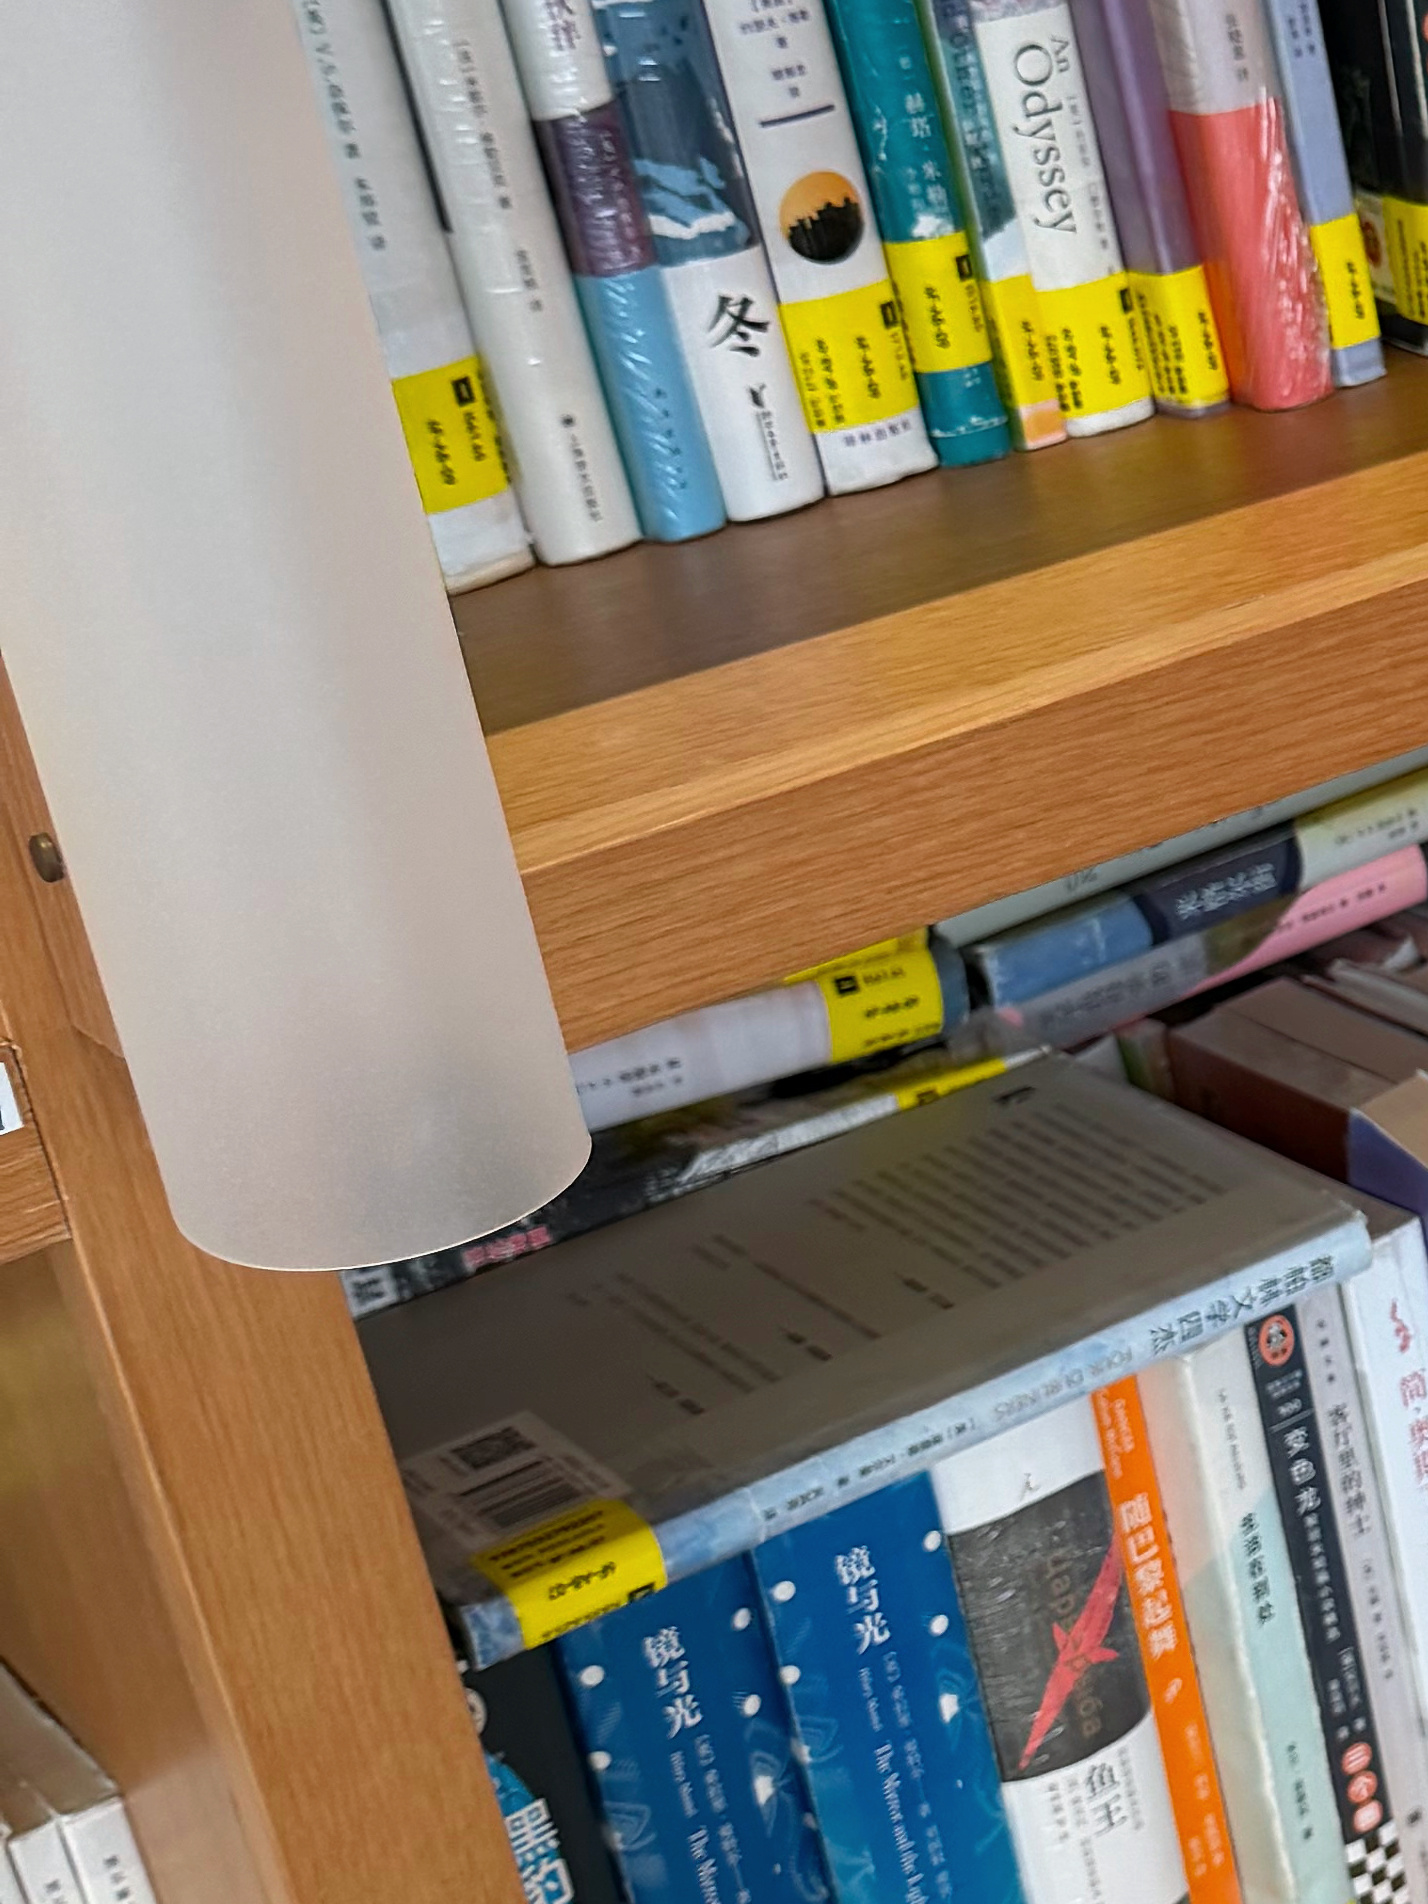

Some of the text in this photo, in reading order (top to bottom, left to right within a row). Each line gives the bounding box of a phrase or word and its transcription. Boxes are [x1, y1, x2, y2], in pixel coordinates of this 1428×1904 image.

[1049, 34, 1072, 73] An
[1012, 42, 1079, 236] Odyssey
[707, 292, 771, 358] 冬
[1149, 1252, 1335, 1356] 都柏林文学四杰
[1282, 1427, 1321, 1515] 变色龙
[834, 1543, 892, 1656] 镜与光
[642, 1625, 704, 1740] 镜与光
[1084, 1759, 1129, 1836] 鱼王
